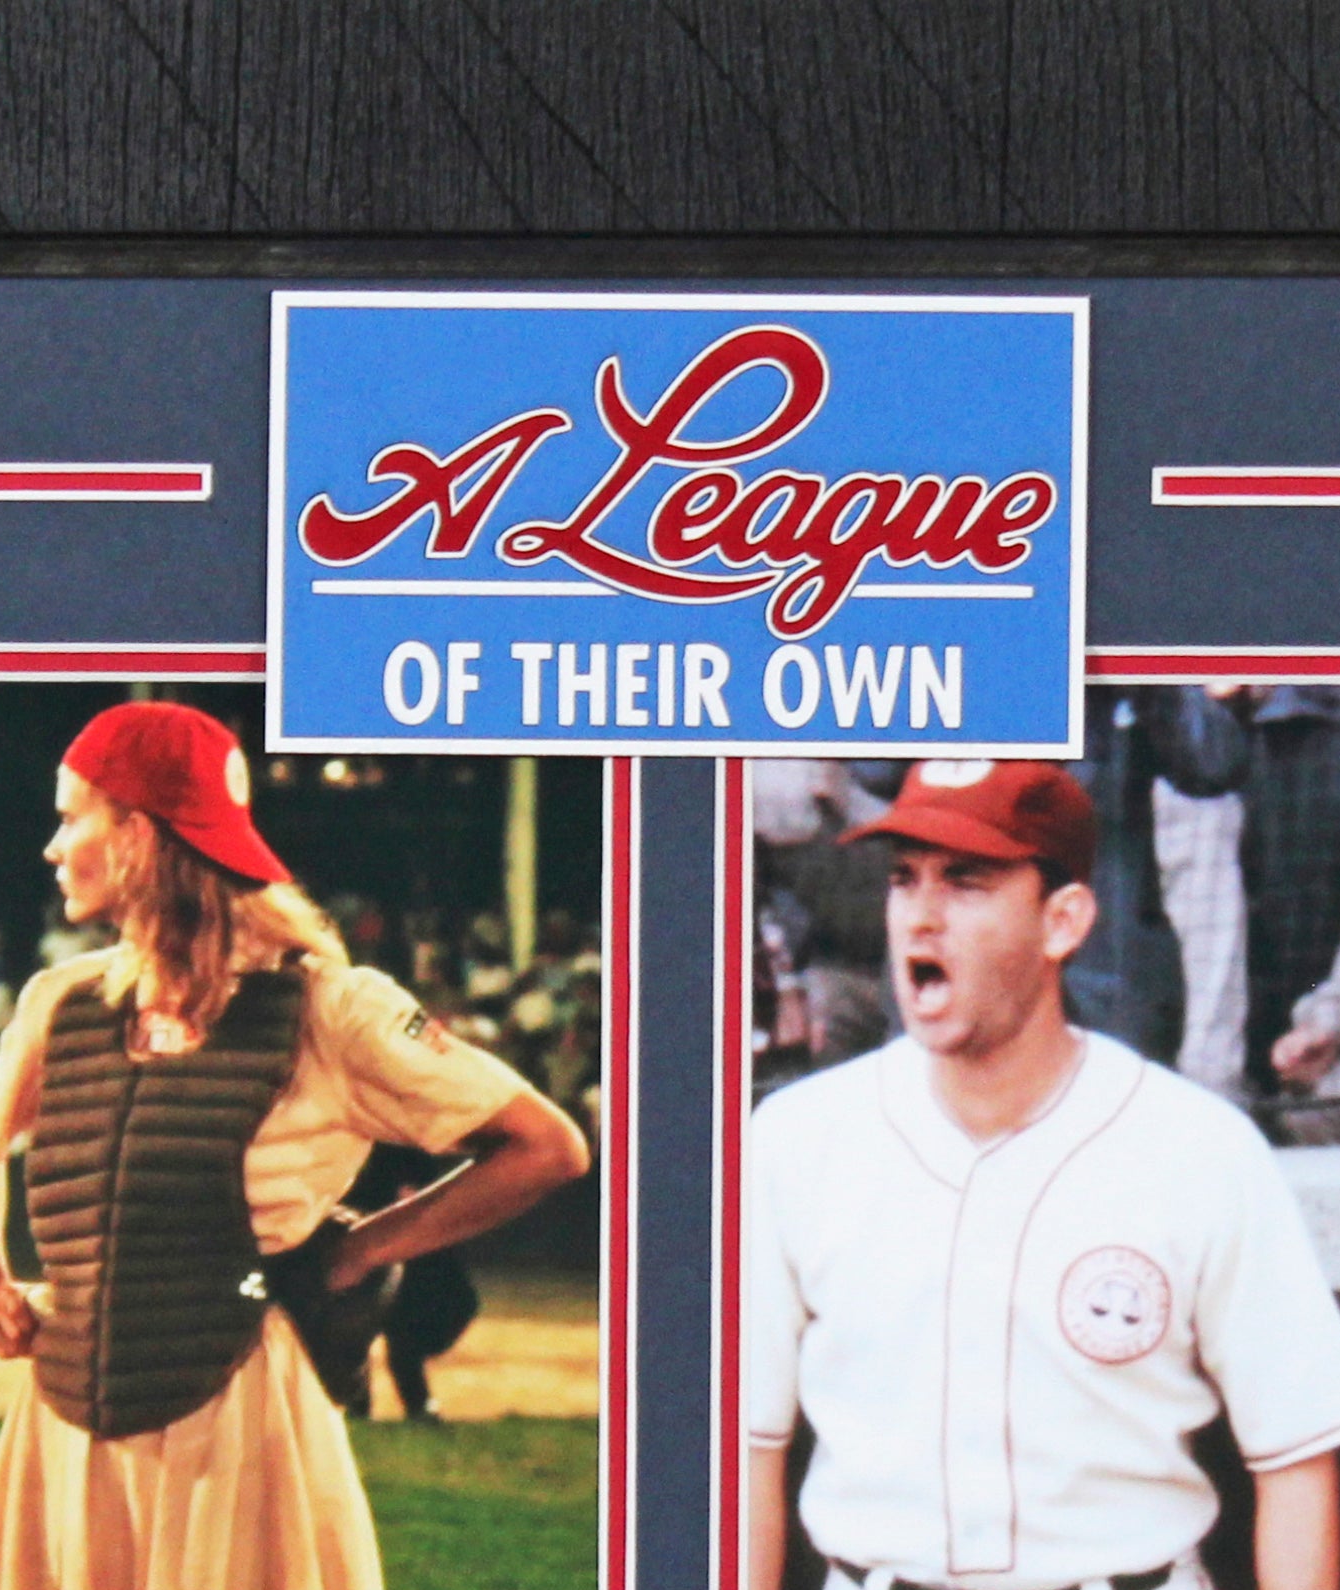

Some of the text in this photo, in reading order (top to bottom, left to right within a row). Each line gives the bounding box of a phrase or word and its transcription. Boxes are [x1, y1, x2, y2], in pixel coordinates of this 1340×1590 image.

[299, 324, 1057, 641] A League
[383, 640, 963, 729] OF THEIR OWN
